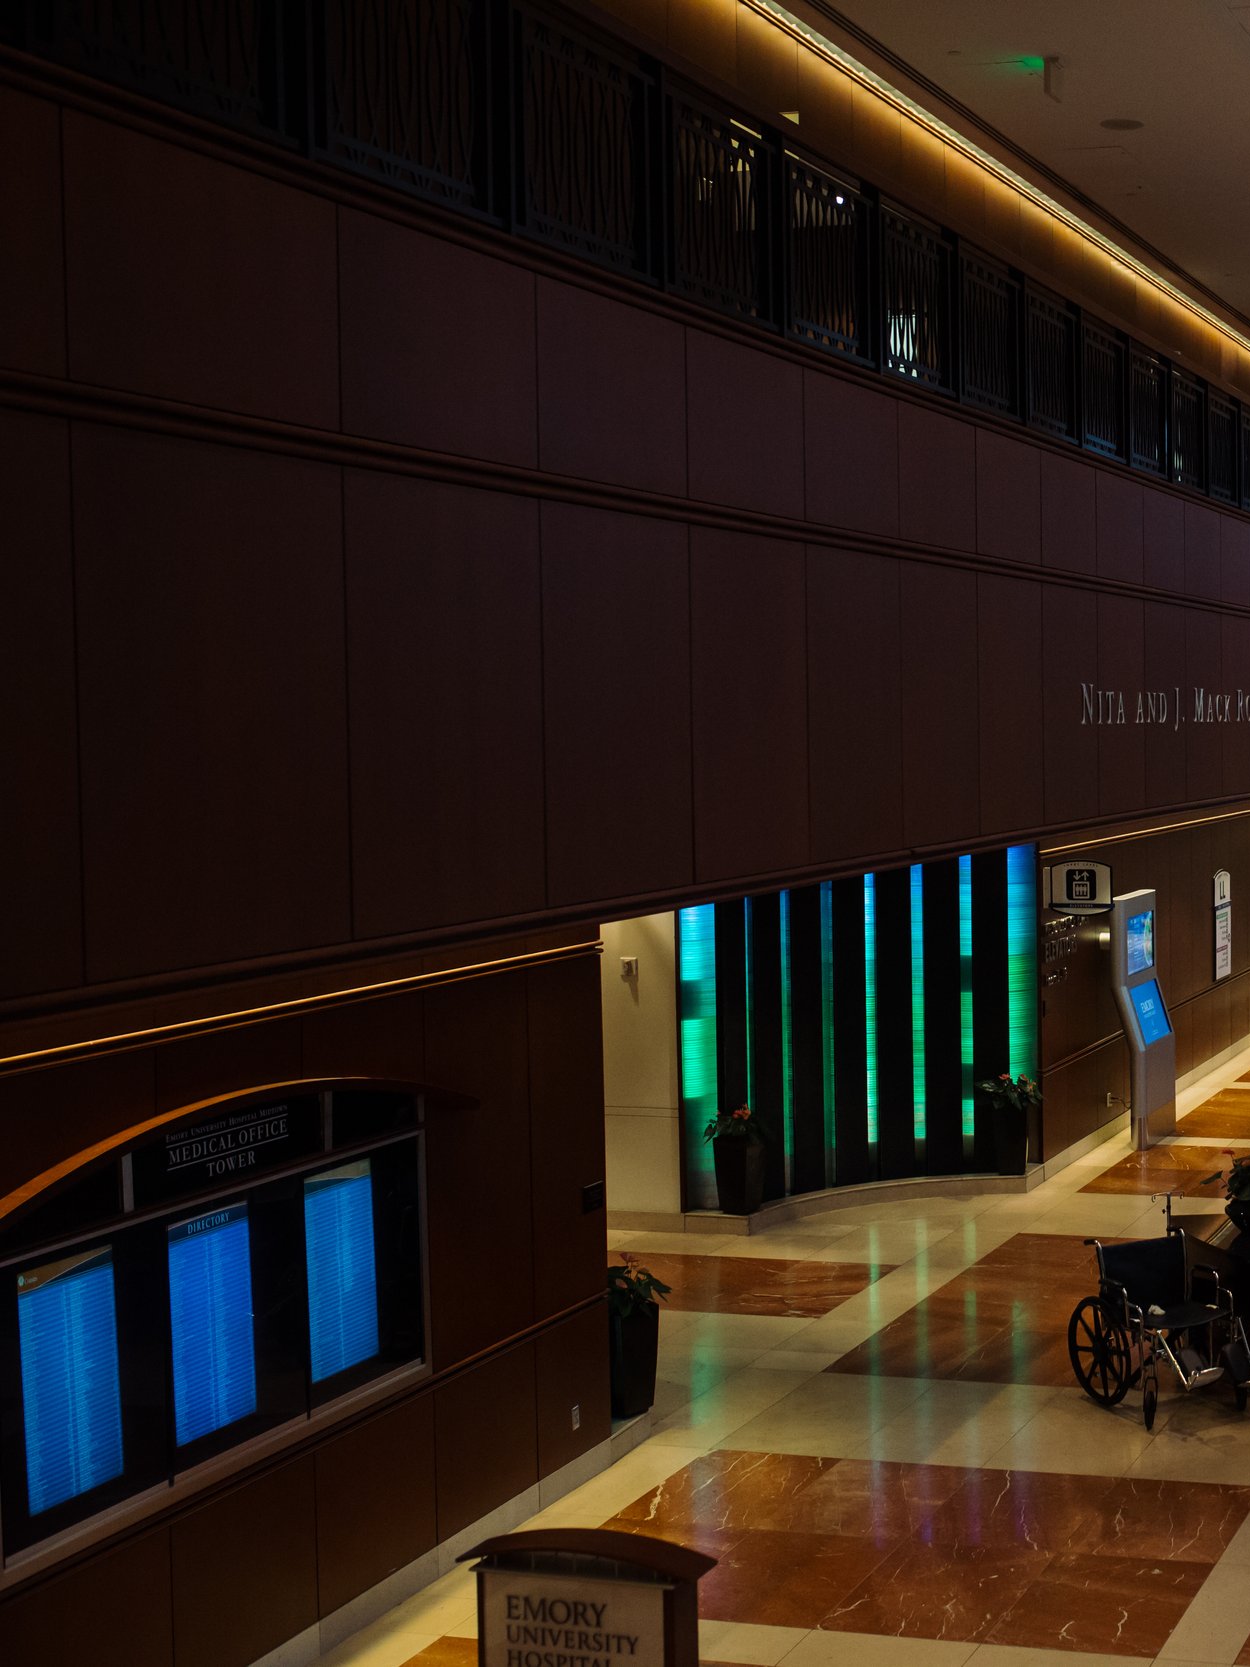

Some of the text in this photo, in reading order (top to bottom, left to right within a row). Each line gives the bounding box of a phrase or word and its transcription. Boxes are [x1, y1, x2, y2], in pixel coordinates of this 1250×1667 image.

[1081, 683, 1126, 725] NITA
[1135, 691, 1167, 724] AND
[1174, 687, 1185, 732] J.
[1193, 687, 1231, 723] MACK
[190, 1120, 227, 1136] UNIVERSITY
[229, 1112, 257, 1126] HOSPITAL
[168, 1119, 288, 1165] MEDICAL OFFICE
[207, 1150, 256, 1177] TOWER
[187, 1212, 230, 1234] DIRECTORY
[506, 1595, 607, 1627] EMORY
[506, 1625, 639, 1655] UNIVERSITY
